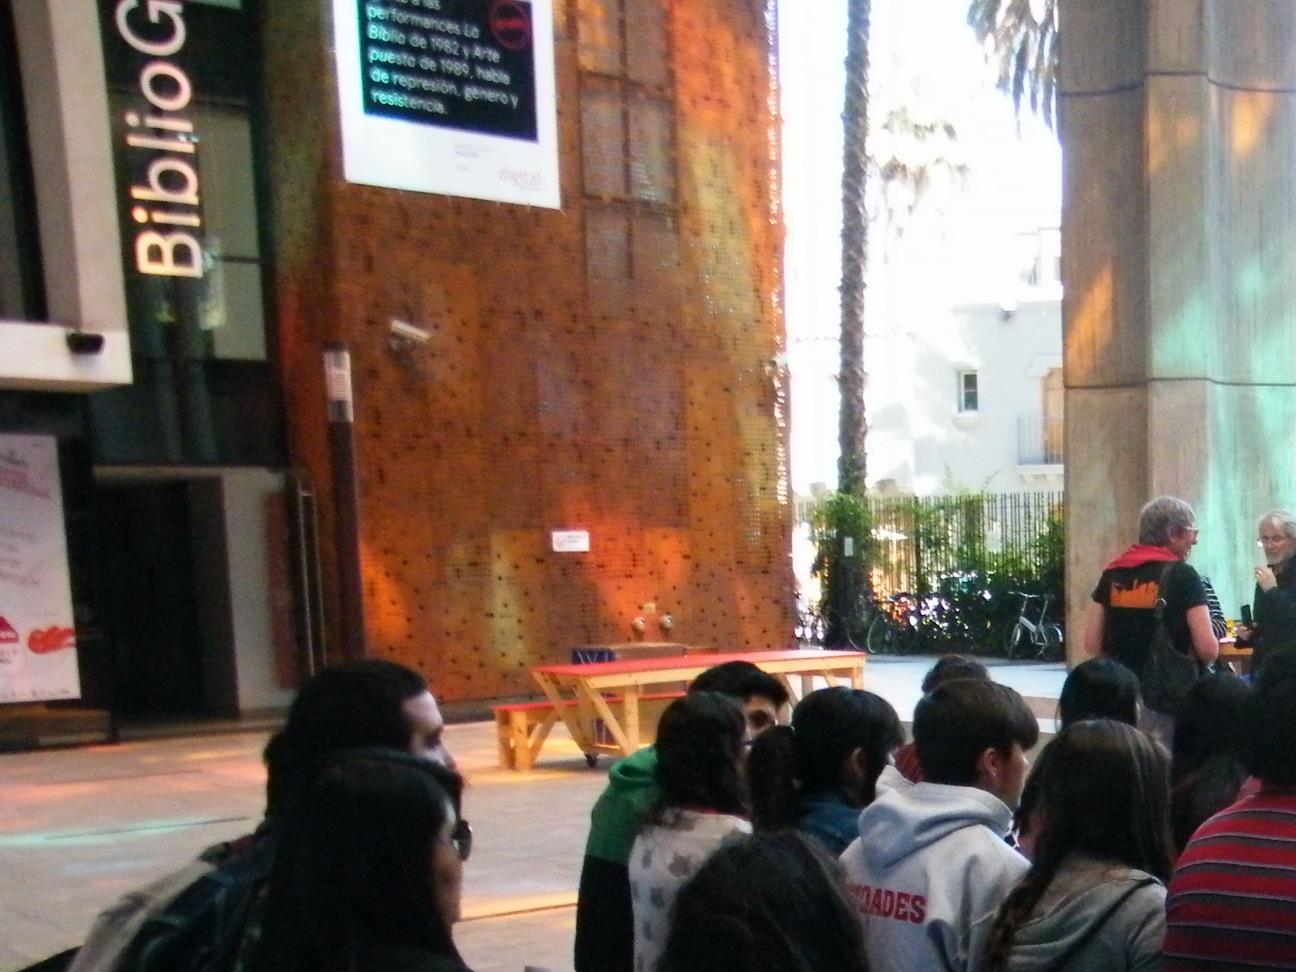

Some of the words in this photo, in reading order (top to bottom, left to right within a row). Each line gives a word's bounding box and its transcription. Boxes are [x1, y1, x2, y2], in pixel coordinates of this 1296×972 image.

[367, 5, 460, 35] performances
[409, 33, 427, 49] de
[431, 37, 459, 56] 1982
[473, 45, 500, 63] Arte
[370, 66, 389, 84] de
[419, 54, 437, 71] de
[371, 89, 448, 115] resistencia.
